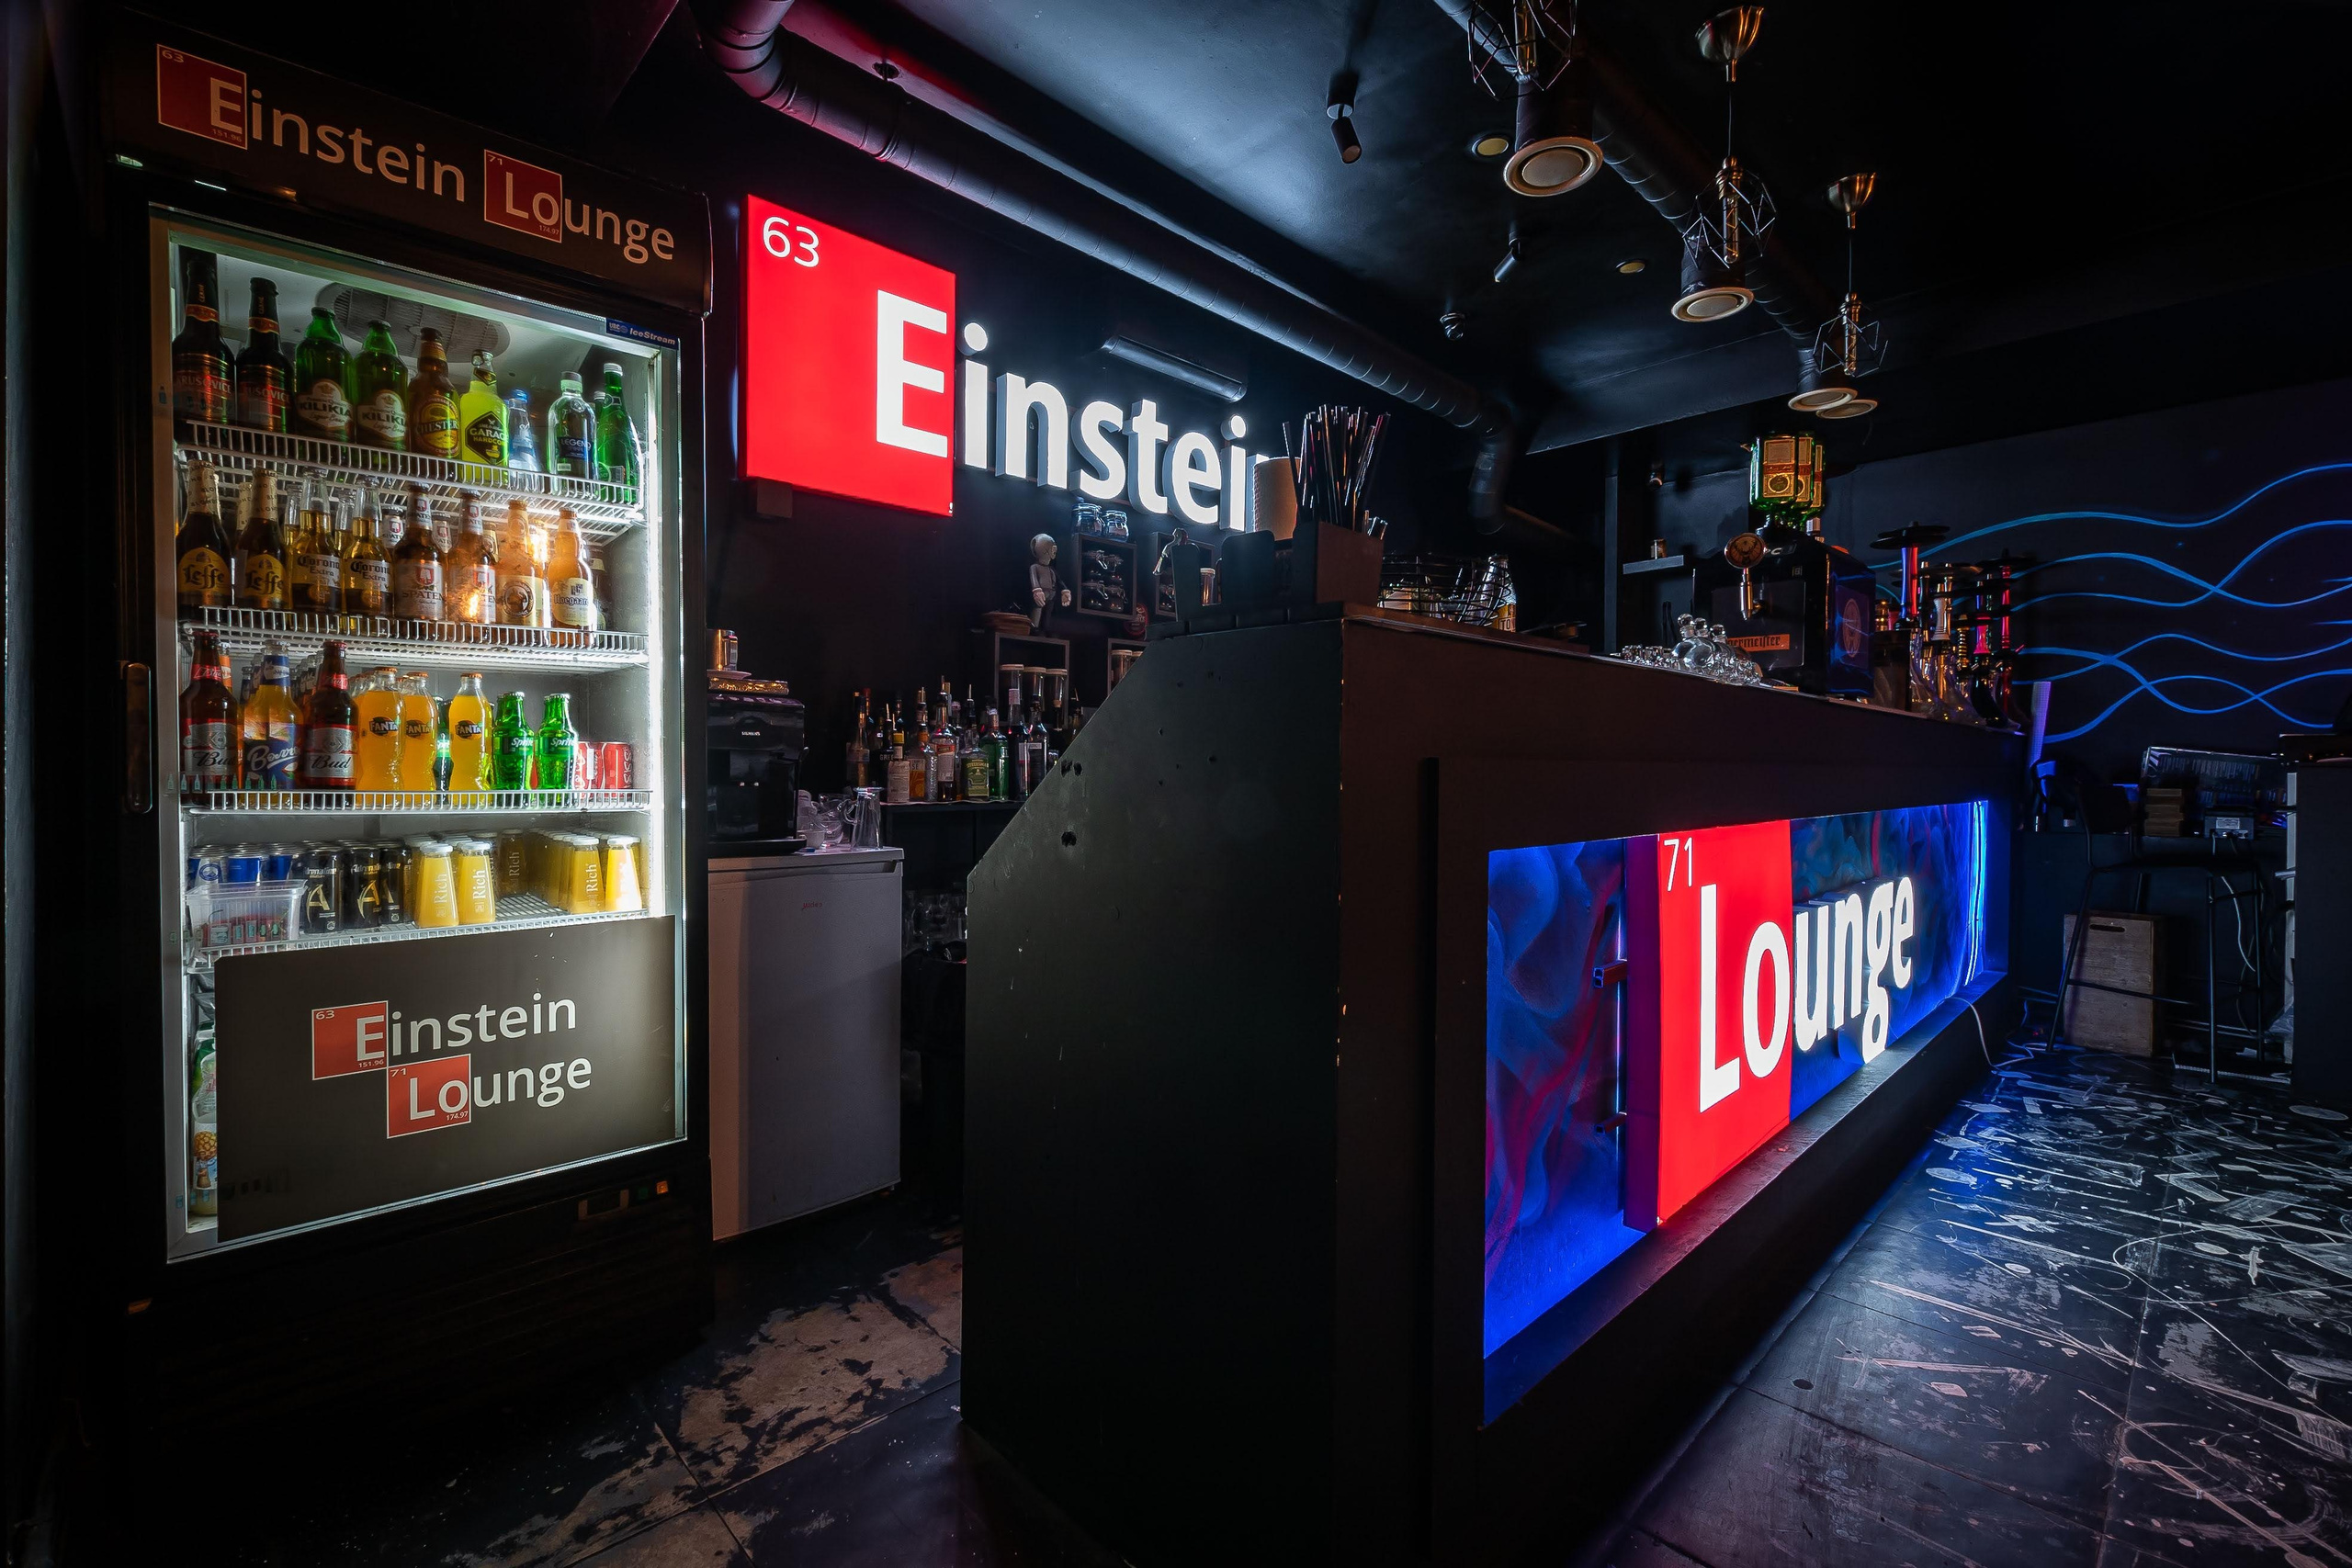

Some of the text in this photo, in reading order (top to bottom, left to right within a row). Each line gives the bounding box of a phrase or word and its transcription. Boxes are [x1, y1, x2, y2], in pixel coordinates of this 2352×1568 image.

[161, 50, 185, 63] 63
[487, 154, 503, 165] 71
[210, 76, 674, 265] Einstein Lounge
[761, 215, 820, 268] 63
[629, 327, 676, 345] IceStream
[361, 411, 406, 428] KILIKI
[876, 289, 1272, 533] Einstei
[560, 438, 592, 451] LEGEND
[185, 563, 225, 589] Leffe
[310, 566, 334, 577] Extra
[362, 571, 386, 582] Extra
[246, 570, 285, 595] Leffe
[402, 590, 445, 602] SPATEN
[370, 721, 399, 732] FANTA
[456, 724, 481, 734] FANTA
[311, 754, 352, 770] Bud
[509, 852, 520, 876] Rich
[1664, 837, 1693, 892] 71
[472, 869, 487, 900] Rich
[585, 863, 599, 892] Rich
[434, 873, 449, 904] Rich
[1699, 876, 1915, 1113] Lounge
[315, 1010, 335, 1021] 63
[356, 992, 576, 1062] Einstein
[358, 1058, 385, 1068] 151.96
[390, 1067, 407, 1078] 71
[409, 1057, 592, 1121] Lounge
[446, 1111, 469, 1121] 174.97
